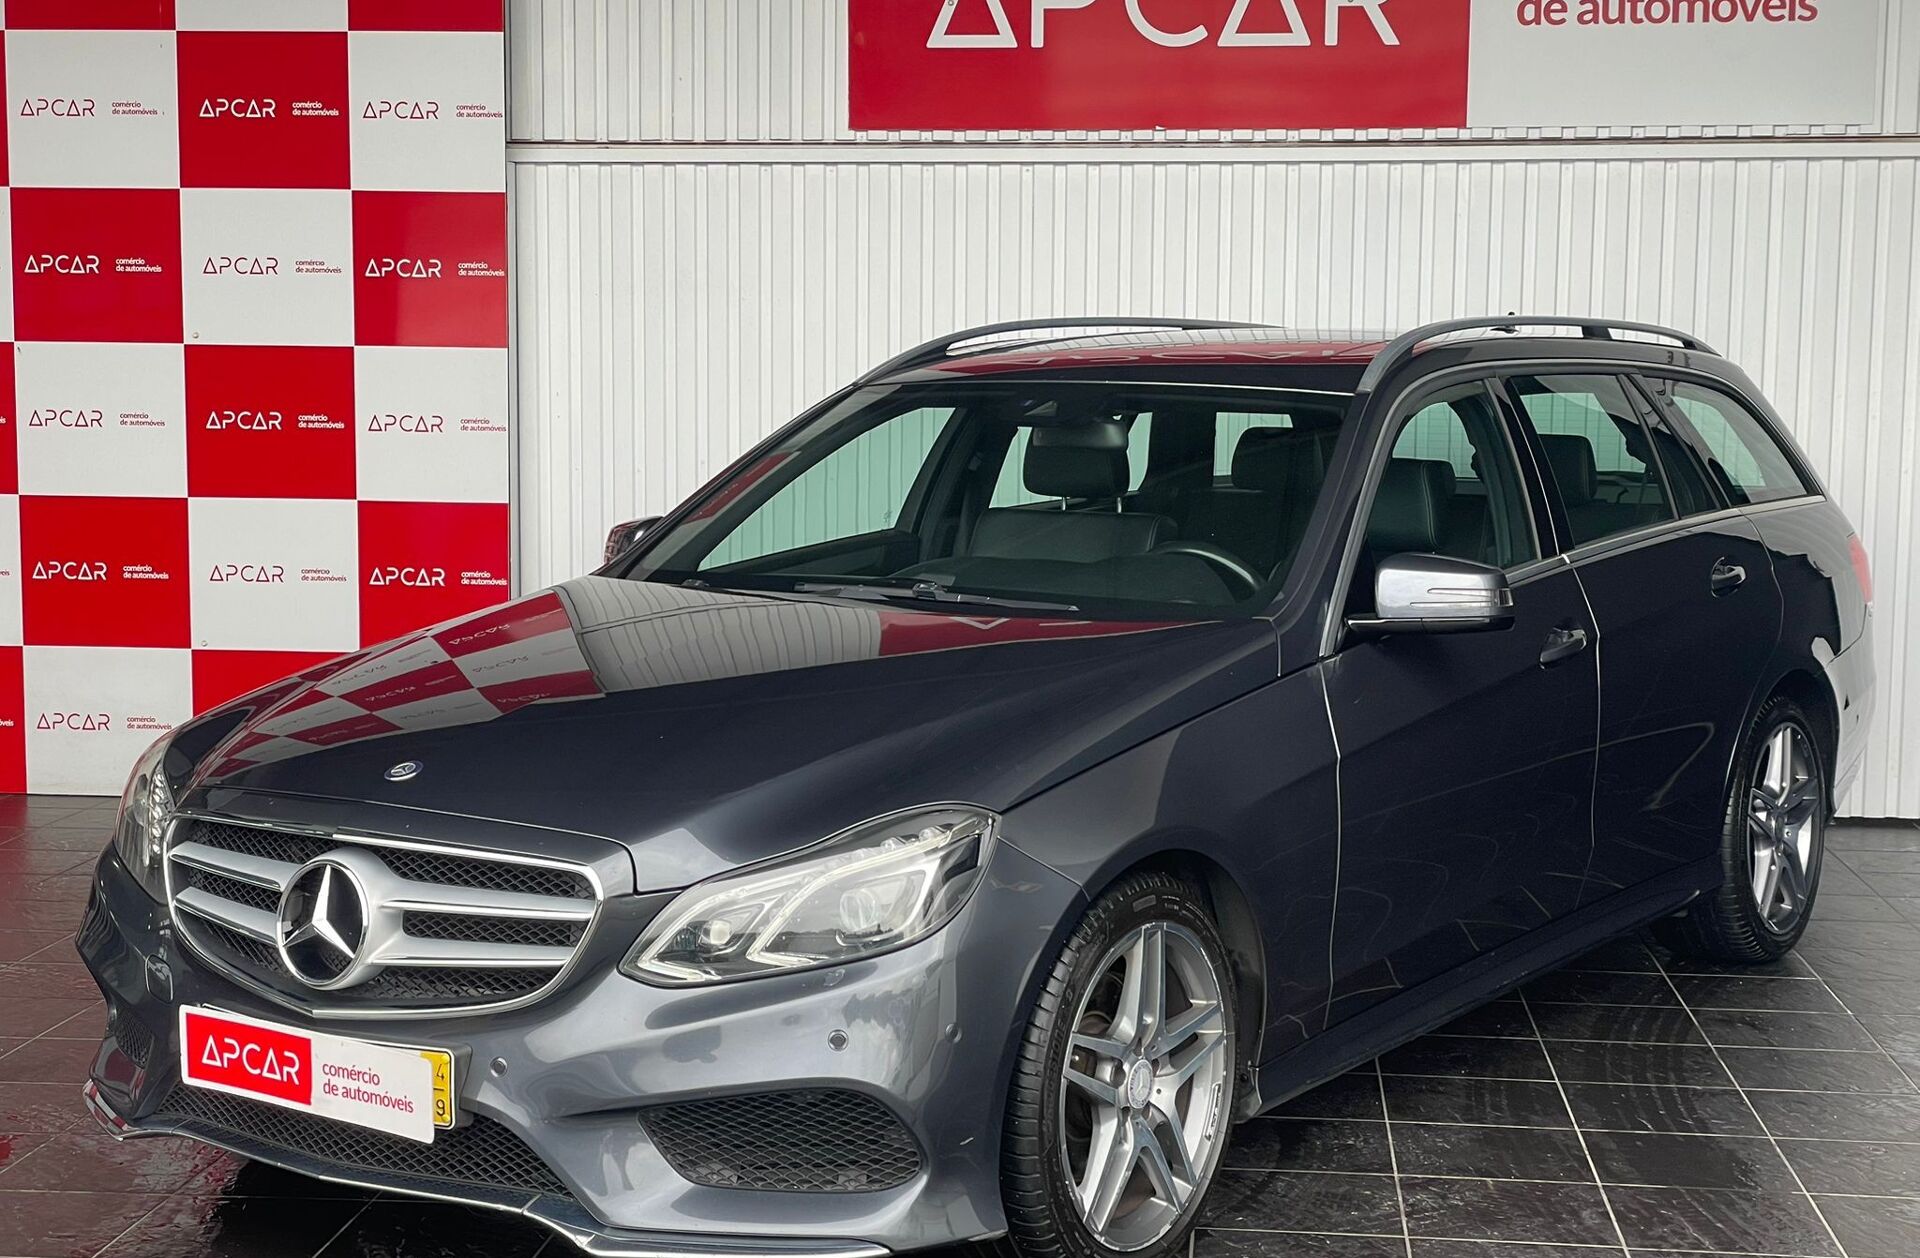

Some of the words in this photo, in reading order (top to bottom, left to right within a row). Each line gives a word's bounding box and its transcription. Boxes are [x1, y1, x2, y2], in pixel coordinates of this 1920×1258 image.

[1517, 0, 1568, 25] de
[21, 99, 94, 116] APCAR
[121, 108, 157, 116] automóveis
[200, 99, 275, 117] APCAR
[301, 108, 339, 116] automóveis
[363, 101, 438, 119] APCAR
[25, 255, 99, 273] APCAR
[203, 257, 278, 275] APCAR
[365, 259, 441, 278] APCAR
[29, 410, 102, 427] APCAR
[206, 411, 281, 430] APCAR
[368, 415, 443, 432] APCAR
[32, 562, 107, 580] APCAR
[210, 565, 284, 582] APCAR
[369, 567, 445, 586] APCAR
[37, 713, 110, 731] APCAR
[136, 722, 172, 731] automóveis
[201, 1034, 299, 1085] APCAR
[322, 1063, 381, 1086] comércio
[323, 1079, 339, 1096] de
[341, 1085, 414, 1113] automóveis
